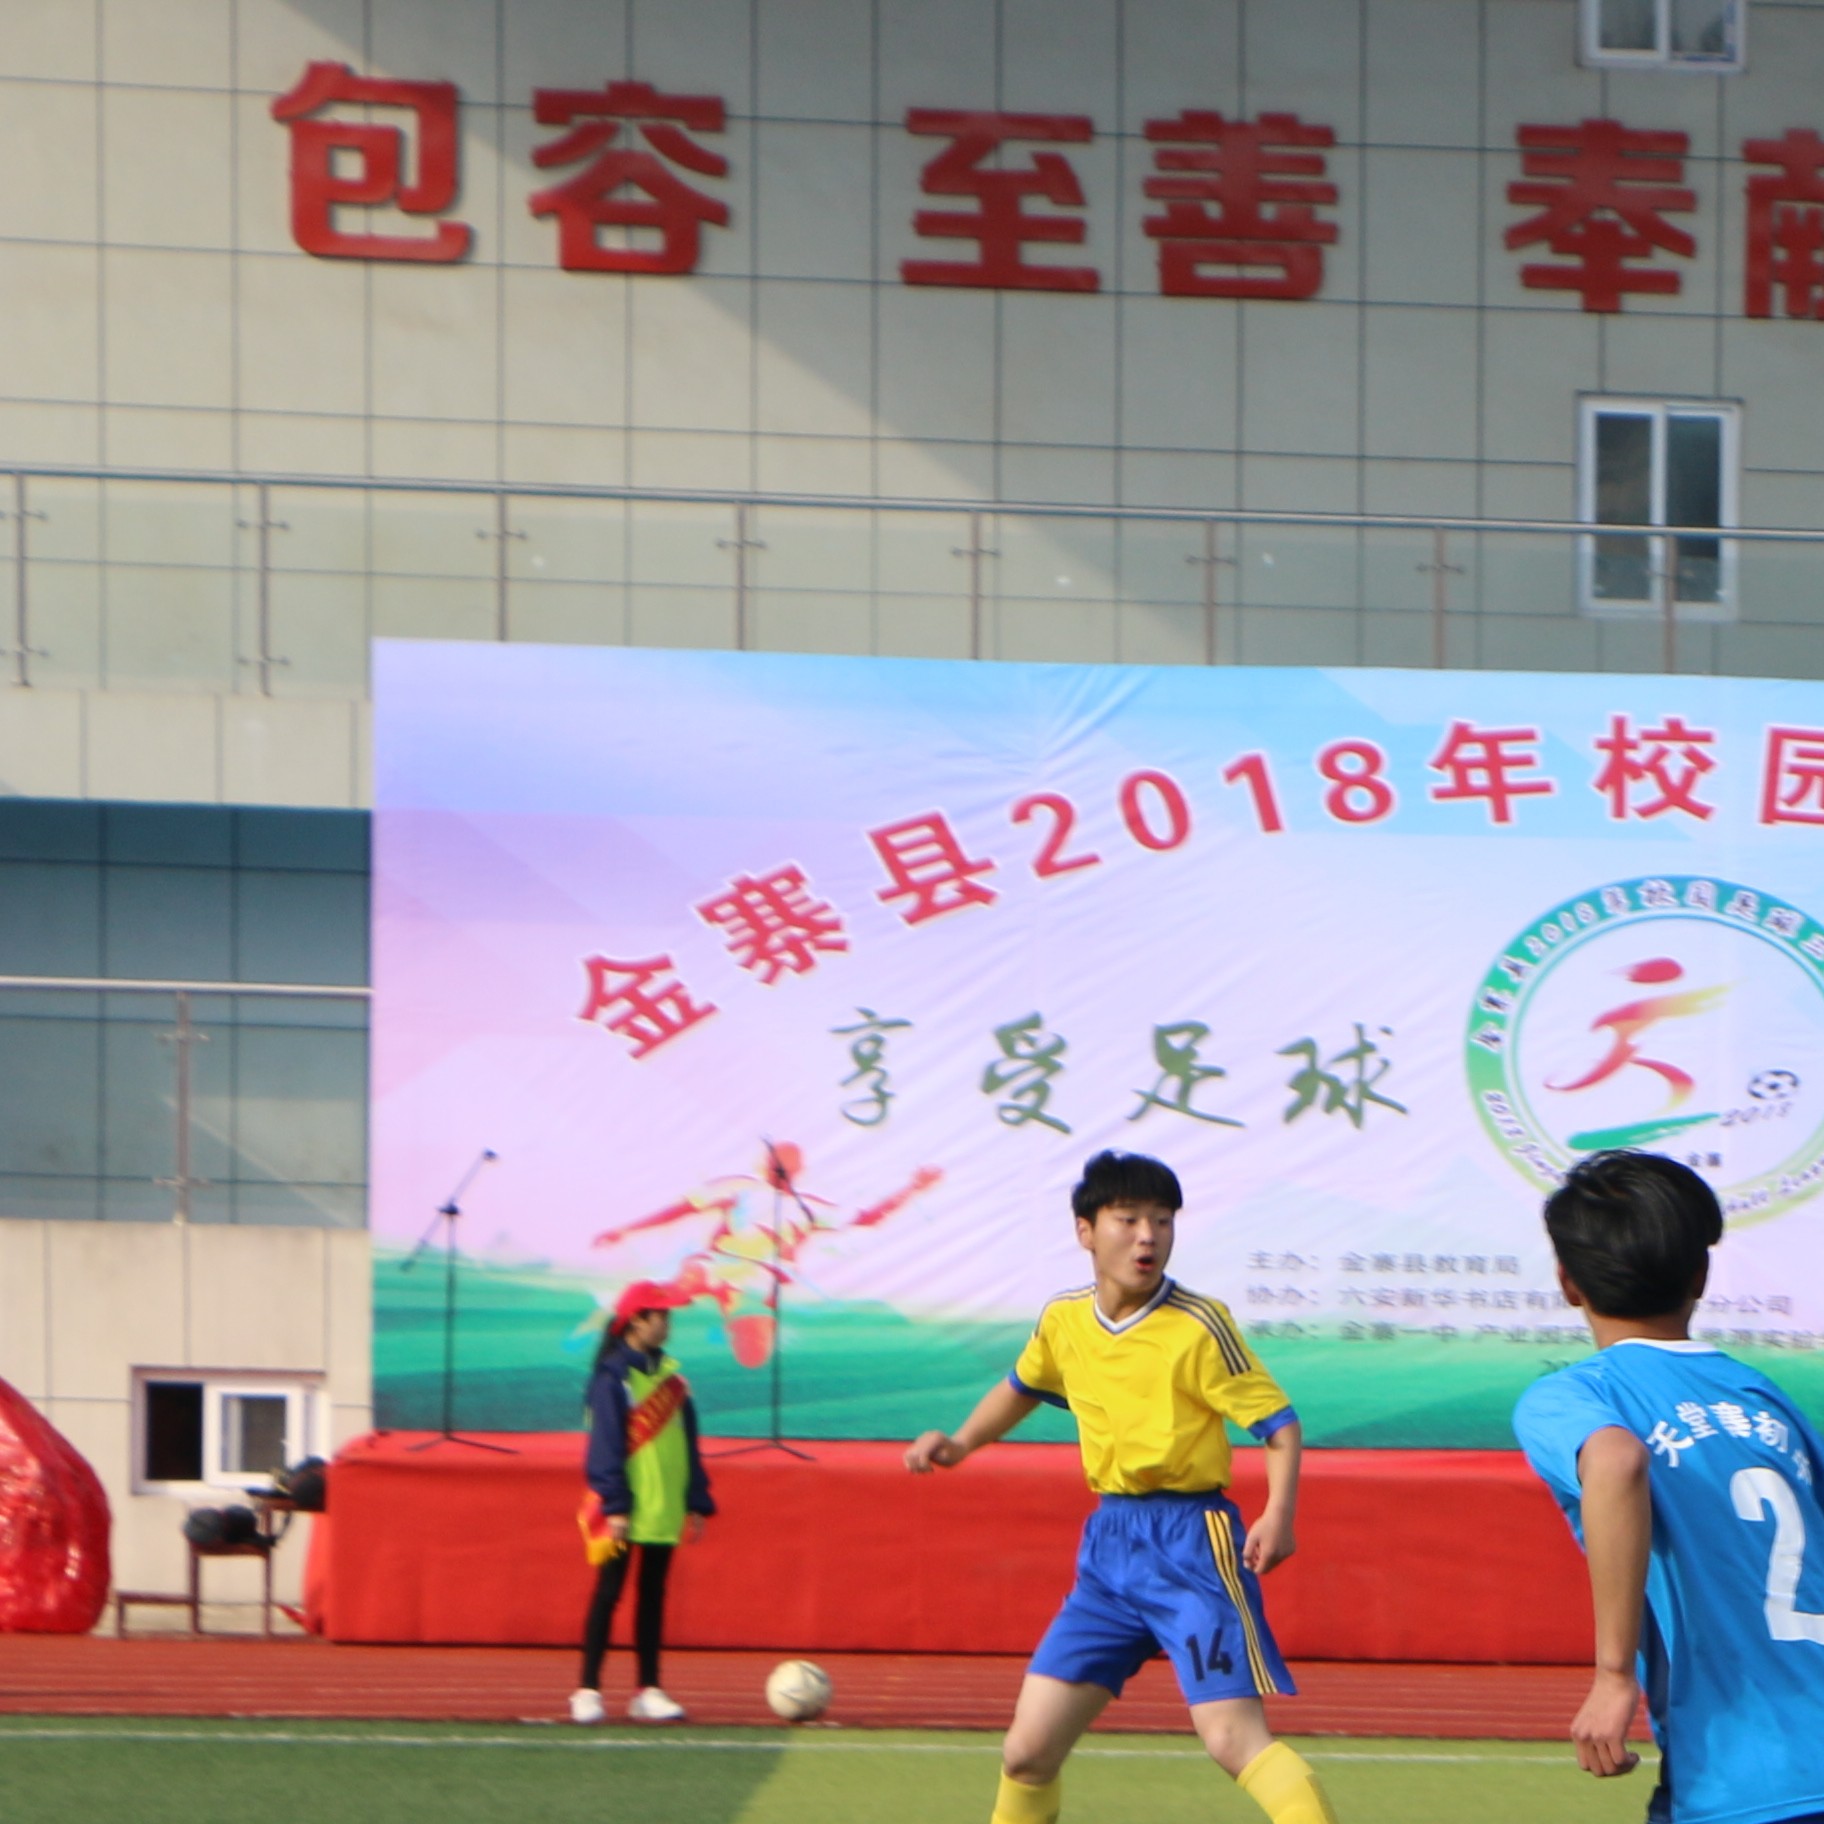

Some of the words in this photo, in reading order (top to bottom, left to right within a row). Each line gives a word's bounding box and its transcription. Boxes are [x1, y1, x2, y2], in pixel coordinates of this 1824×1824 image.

[272, 62, 729, 277] 包容
[900, 108, 1339, 303] 至善
[830, 1008, 1406, 1135] 享受足球
[1185, 1627, 1233, 1682] 14
